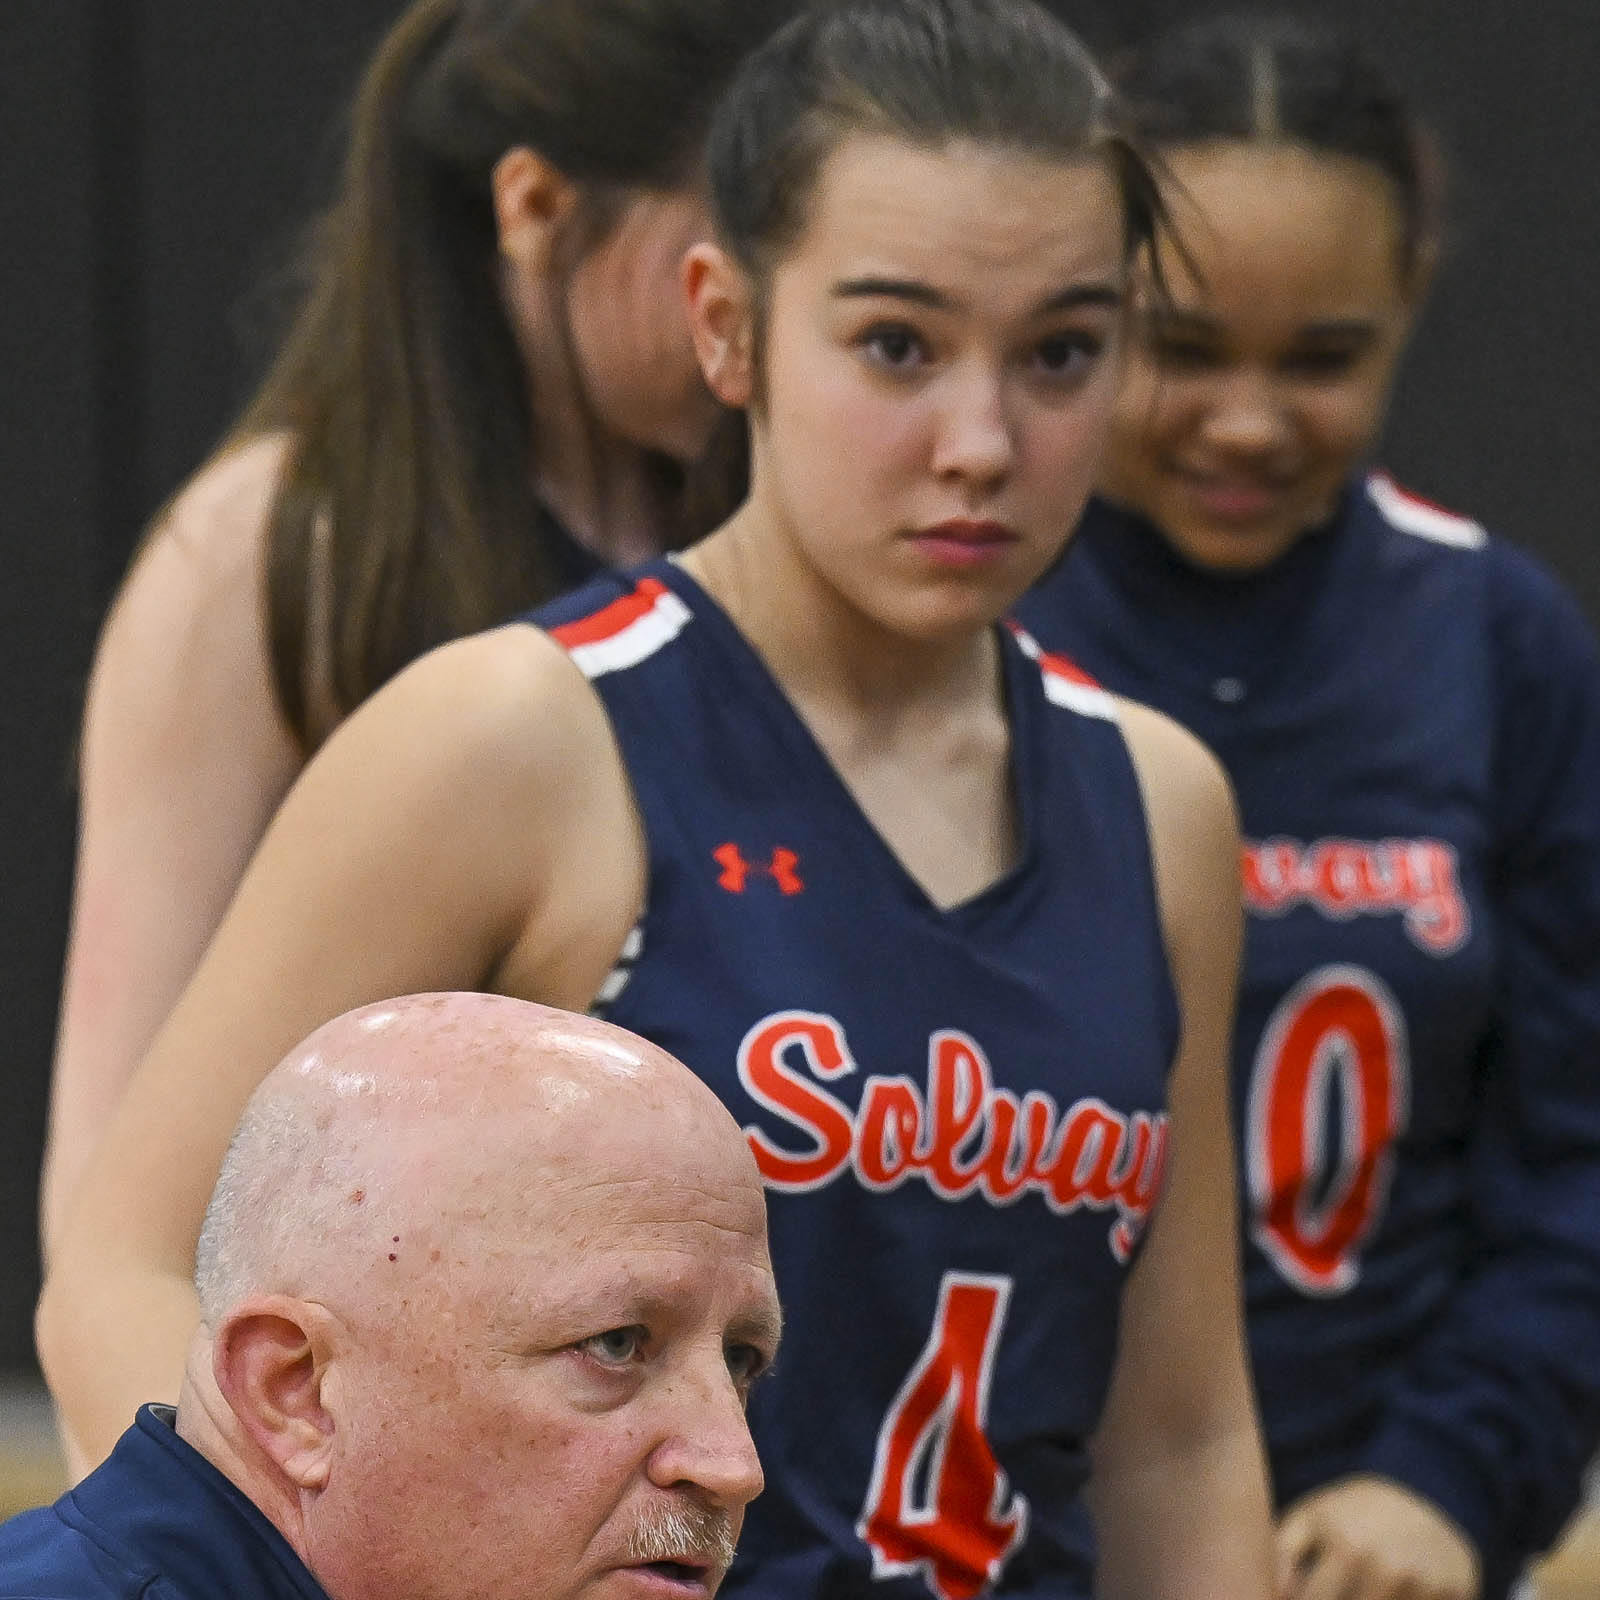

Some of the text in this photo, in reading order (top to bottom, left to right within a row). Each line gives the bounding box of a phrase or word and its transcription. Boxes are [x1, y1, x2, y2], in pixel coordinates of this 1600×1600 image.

[1242, 836, 1472, 956] vay
[737, 1008, 1170, 1264] Solvay
[1245, 963, 1412, 1296] 0
